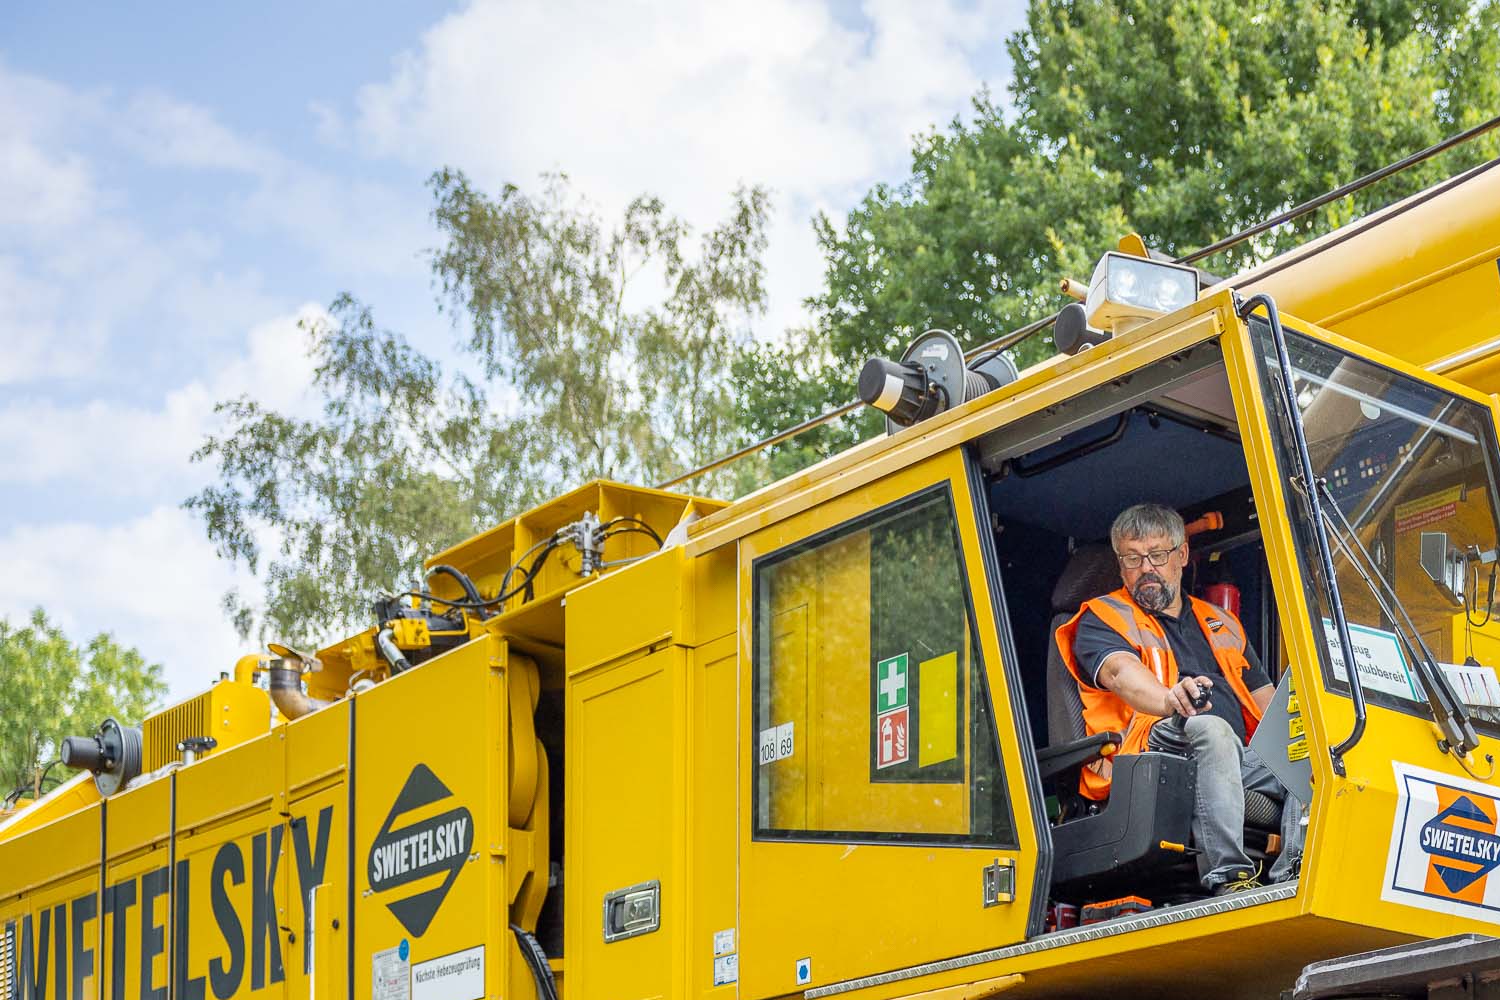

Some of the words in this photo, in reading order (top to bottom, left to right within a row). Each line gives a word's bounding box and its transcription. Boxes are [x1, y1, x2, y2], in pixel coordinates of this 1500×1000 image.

[761, 742, 775, 761] 108
[780, 737, 792, 756] 69
[373, 817, 468, 883] SWIETELSKY
